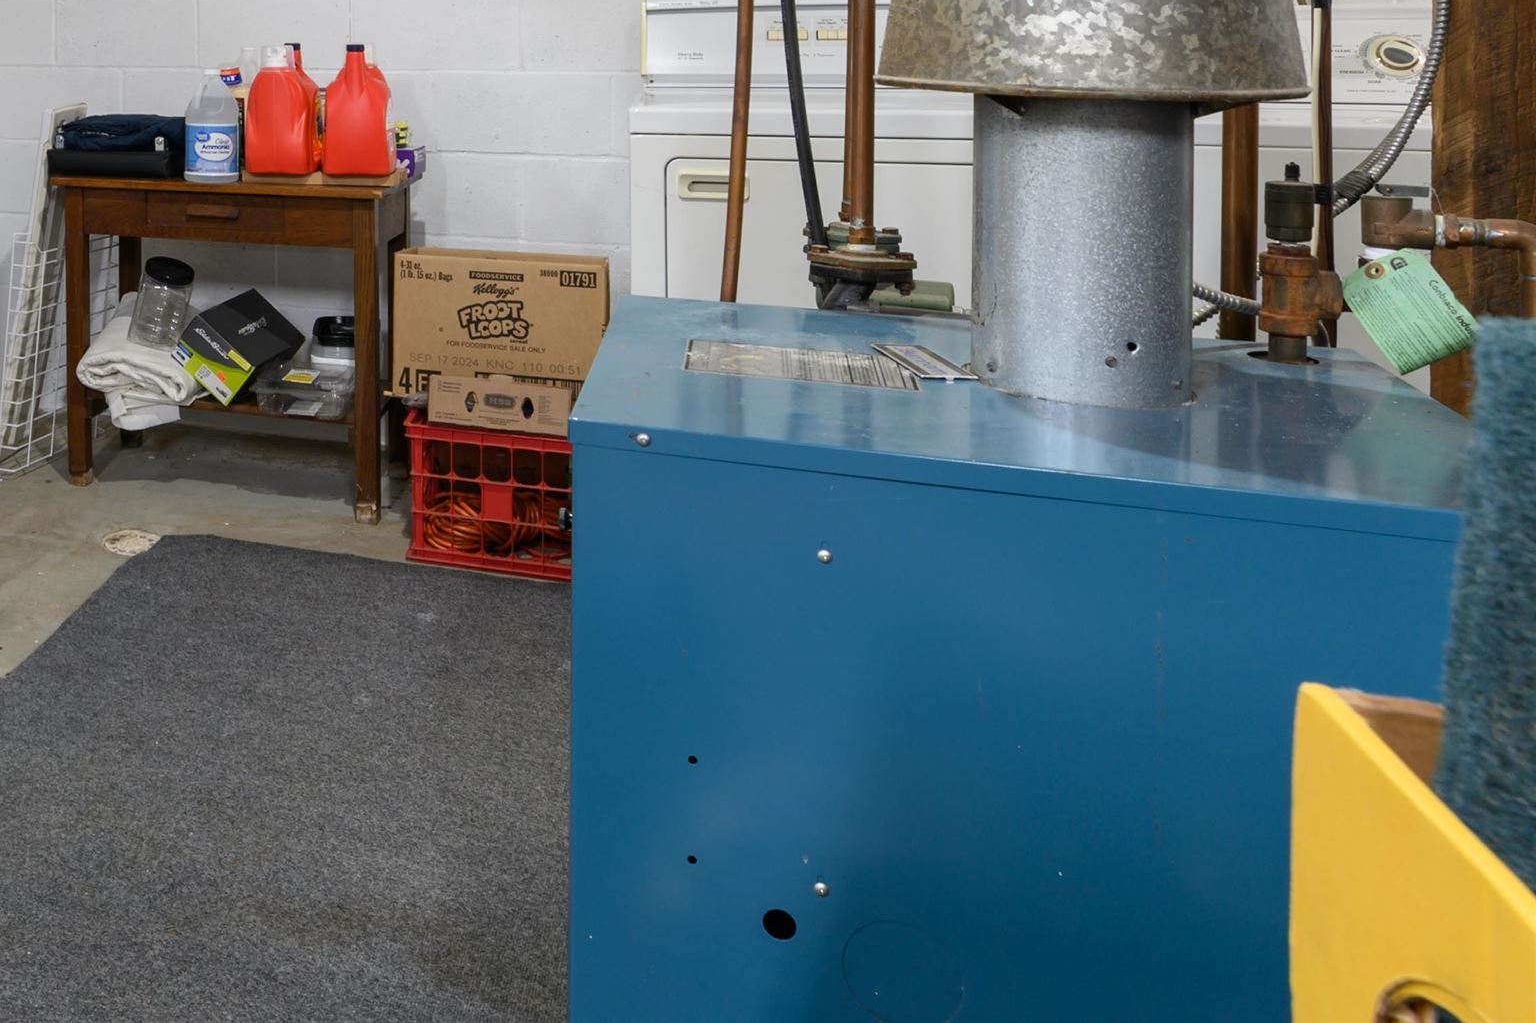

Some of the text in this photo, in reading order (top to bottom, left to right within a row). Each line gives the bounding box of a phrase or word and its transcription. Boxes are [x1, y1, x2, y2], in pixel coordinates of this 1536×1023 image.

[417, 270, 424, 279] 15
[438, 271, 453, 282] Bags
[471, 271, 522, 281] FOODSERVICE
[561, 271, 595, 287] 01791
[473, 283, 515, 298] Kellogg's
[458, 300, 523, 328] FROOT
[1429, 280, 1473, 338] Conbraco Indus
[468, 319, 529, 339] LOOPS
[461, 340, 507, 351] FOODSERVICE
[409, 352, 432, 363] SEP
[438, 355, 448, 364] 17
[452, 356, 479, 367] 2024
[486, 359, 514, 370] KNC
[522, 362, 543, 373] 110
[399, 367, 412, 394] 4
